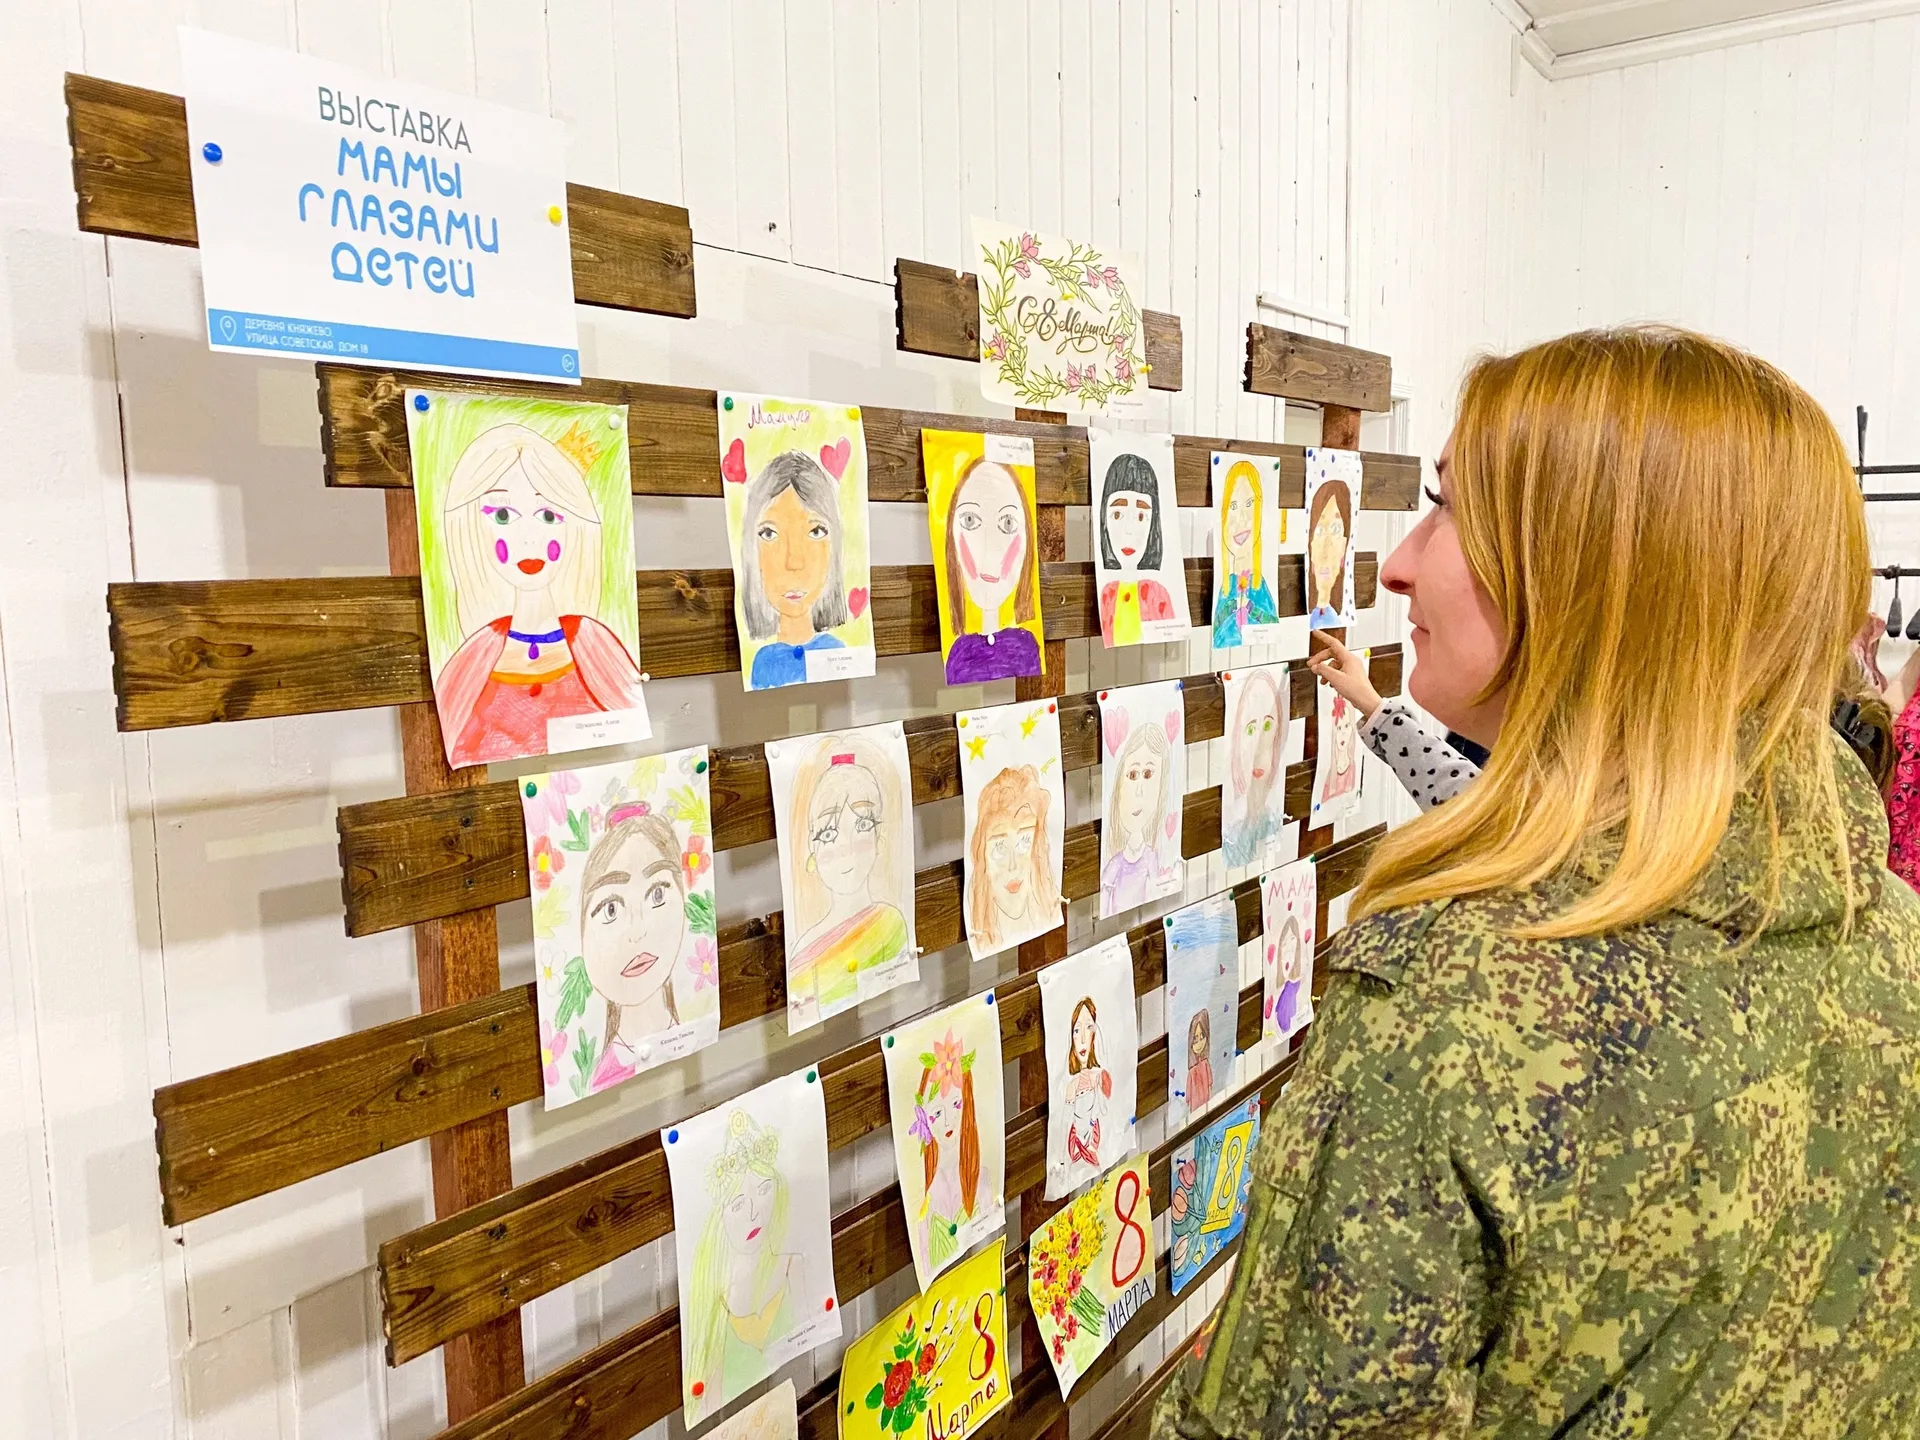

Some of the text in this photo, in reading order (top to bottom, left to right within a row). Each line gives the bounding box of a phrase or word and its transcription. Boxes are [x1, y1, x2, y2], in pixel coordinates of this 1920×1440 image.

[318, 86, 472, 154] ВЫСТАВКА
[338, 137, 463, 200] МАМЫ
[299, 182, 499, 255] ГЛАЗАМИ
[244, 318, 285, 332] ДЕРЕВНЯ
[245, 332, 279, 346] УЛИЦА
[338, 341, 358, 353] ДОМ
[360, 344, 369, 354] 18
[1036, 298, 1058, 341] 8
[1217, 1136, 1242, 1210] 8
[1111, 1170, 1146, 1288] 8
[968, 1292, 996, 1381] 8
[1107, 1278, 1153, 1339] МАРТА
[926, 1378, 999, 1440] Марта
